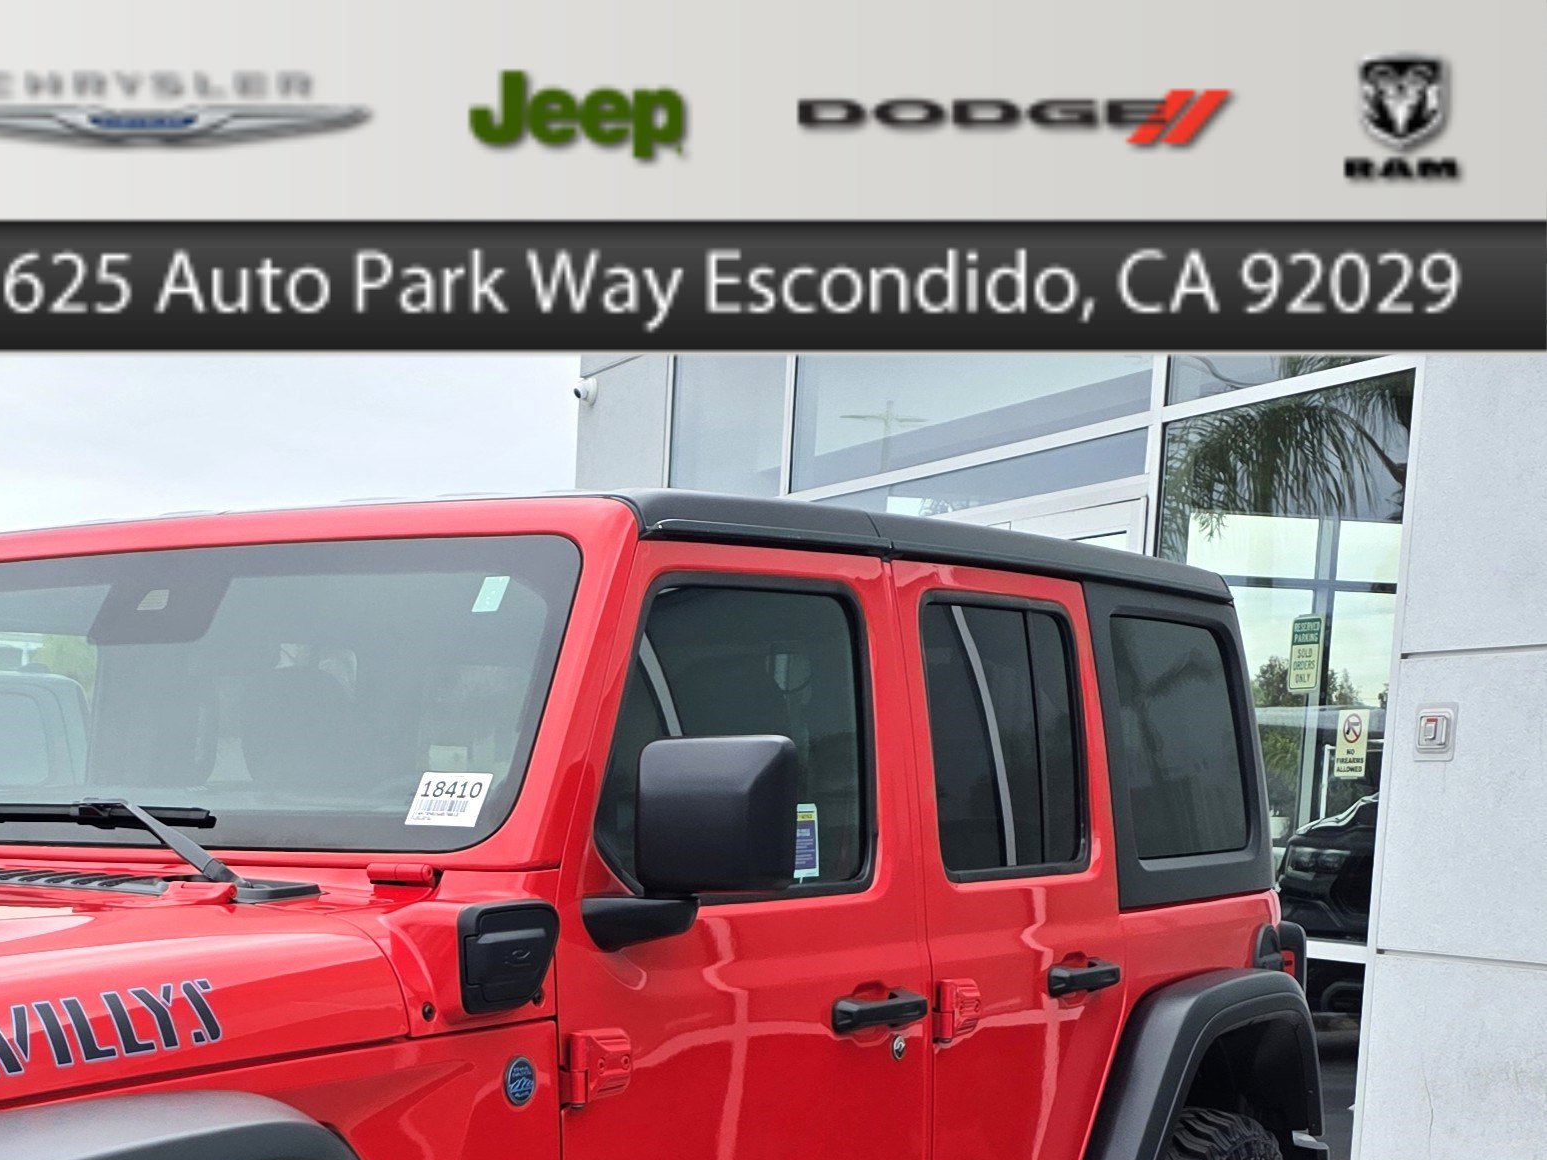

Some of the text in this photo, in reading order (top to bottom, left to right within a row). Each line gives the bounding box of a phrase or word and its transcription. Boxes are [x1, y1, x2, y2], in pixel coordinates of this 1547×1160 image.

[1294, 621, 1321, 633] RESERVED
[1294, 632, 1319, 643] PARKING
[1297, 647, 1313, 659] SOLD
[1293, 660, 1315, 671] ORDERS
[1295, 673, 1311, 684] ONLY
[420, 780, 483, 799] 18410
